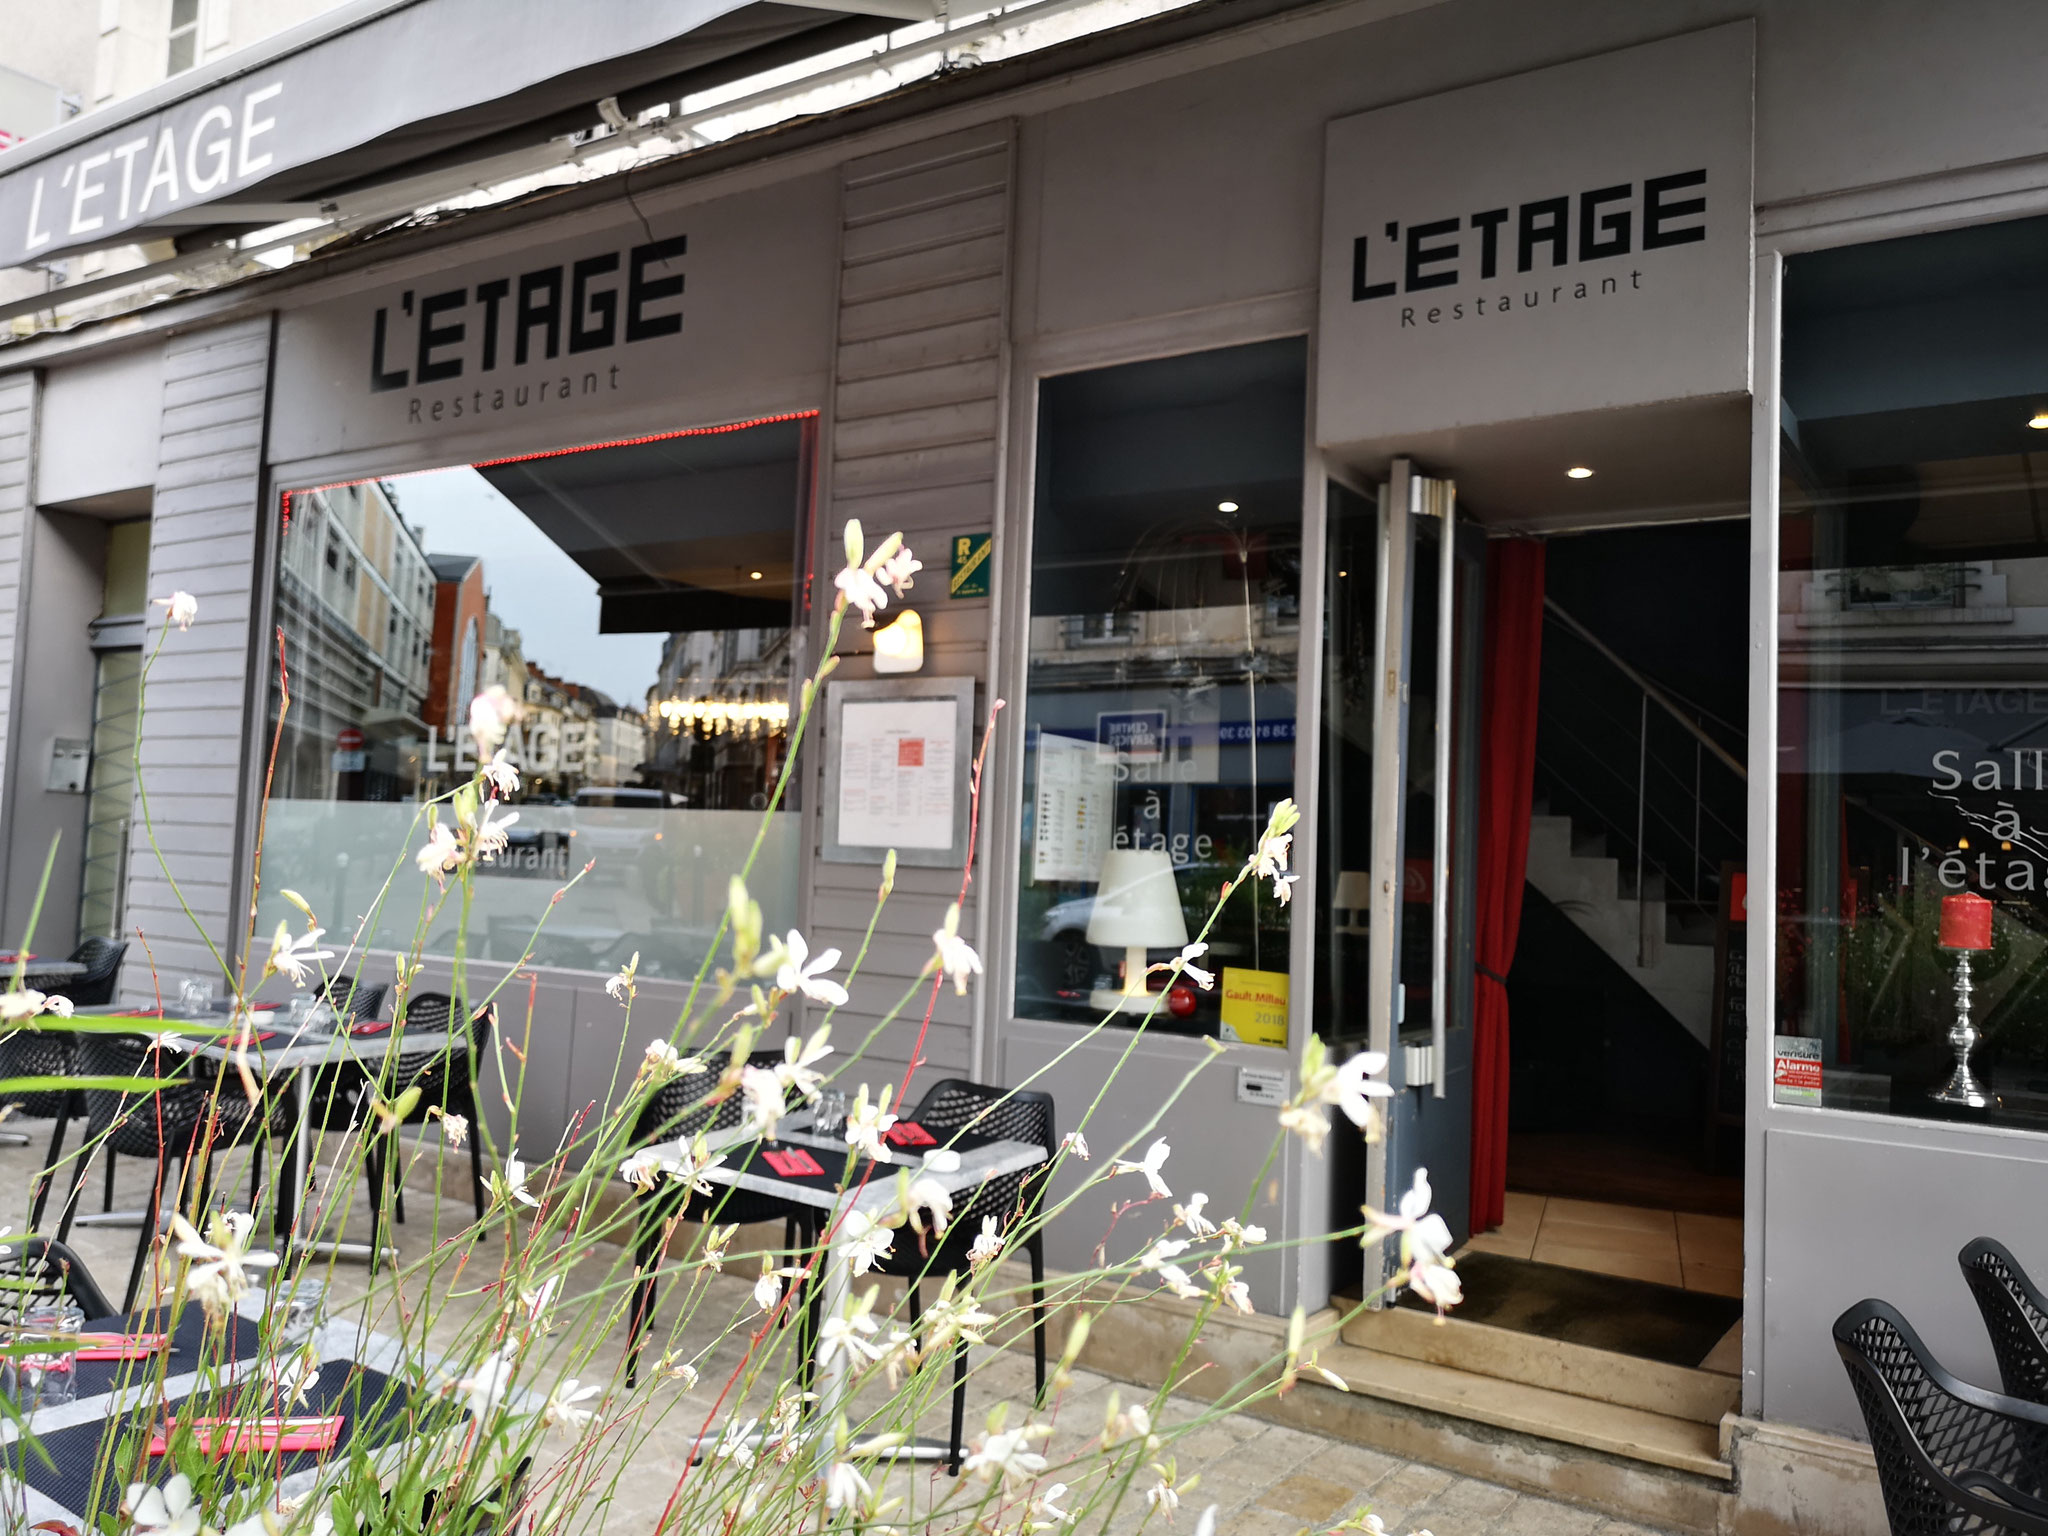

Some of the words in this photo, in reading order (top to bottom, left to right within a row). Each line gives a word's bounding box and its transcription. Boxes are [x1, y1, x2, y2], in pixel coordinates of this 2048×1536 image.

[26, 82, 283, 250] L'ETAGE
[1352, 169, 1706, 302] L'ETAGE
[371, 235, 686, 392] L'ETAGE
[1401, 270, 1643, 327] Restaurant
[408, 364, 621, 423] Restaurant
[957, 538, 971, 555] R
[427, 724, 583, 772] L'EAGE
[1932, 750, 2043, 790] Sall
[1144, 789, 1160, 819] à
[1992, 801, 2021, 840] à
[1113, 825, 1212, 864] étage
[1902, 847, 2048, 893] l'éta
[1255, 1012, 1285, 1026] 2018
[1777, 1059, 1819, 1072] Alarme
